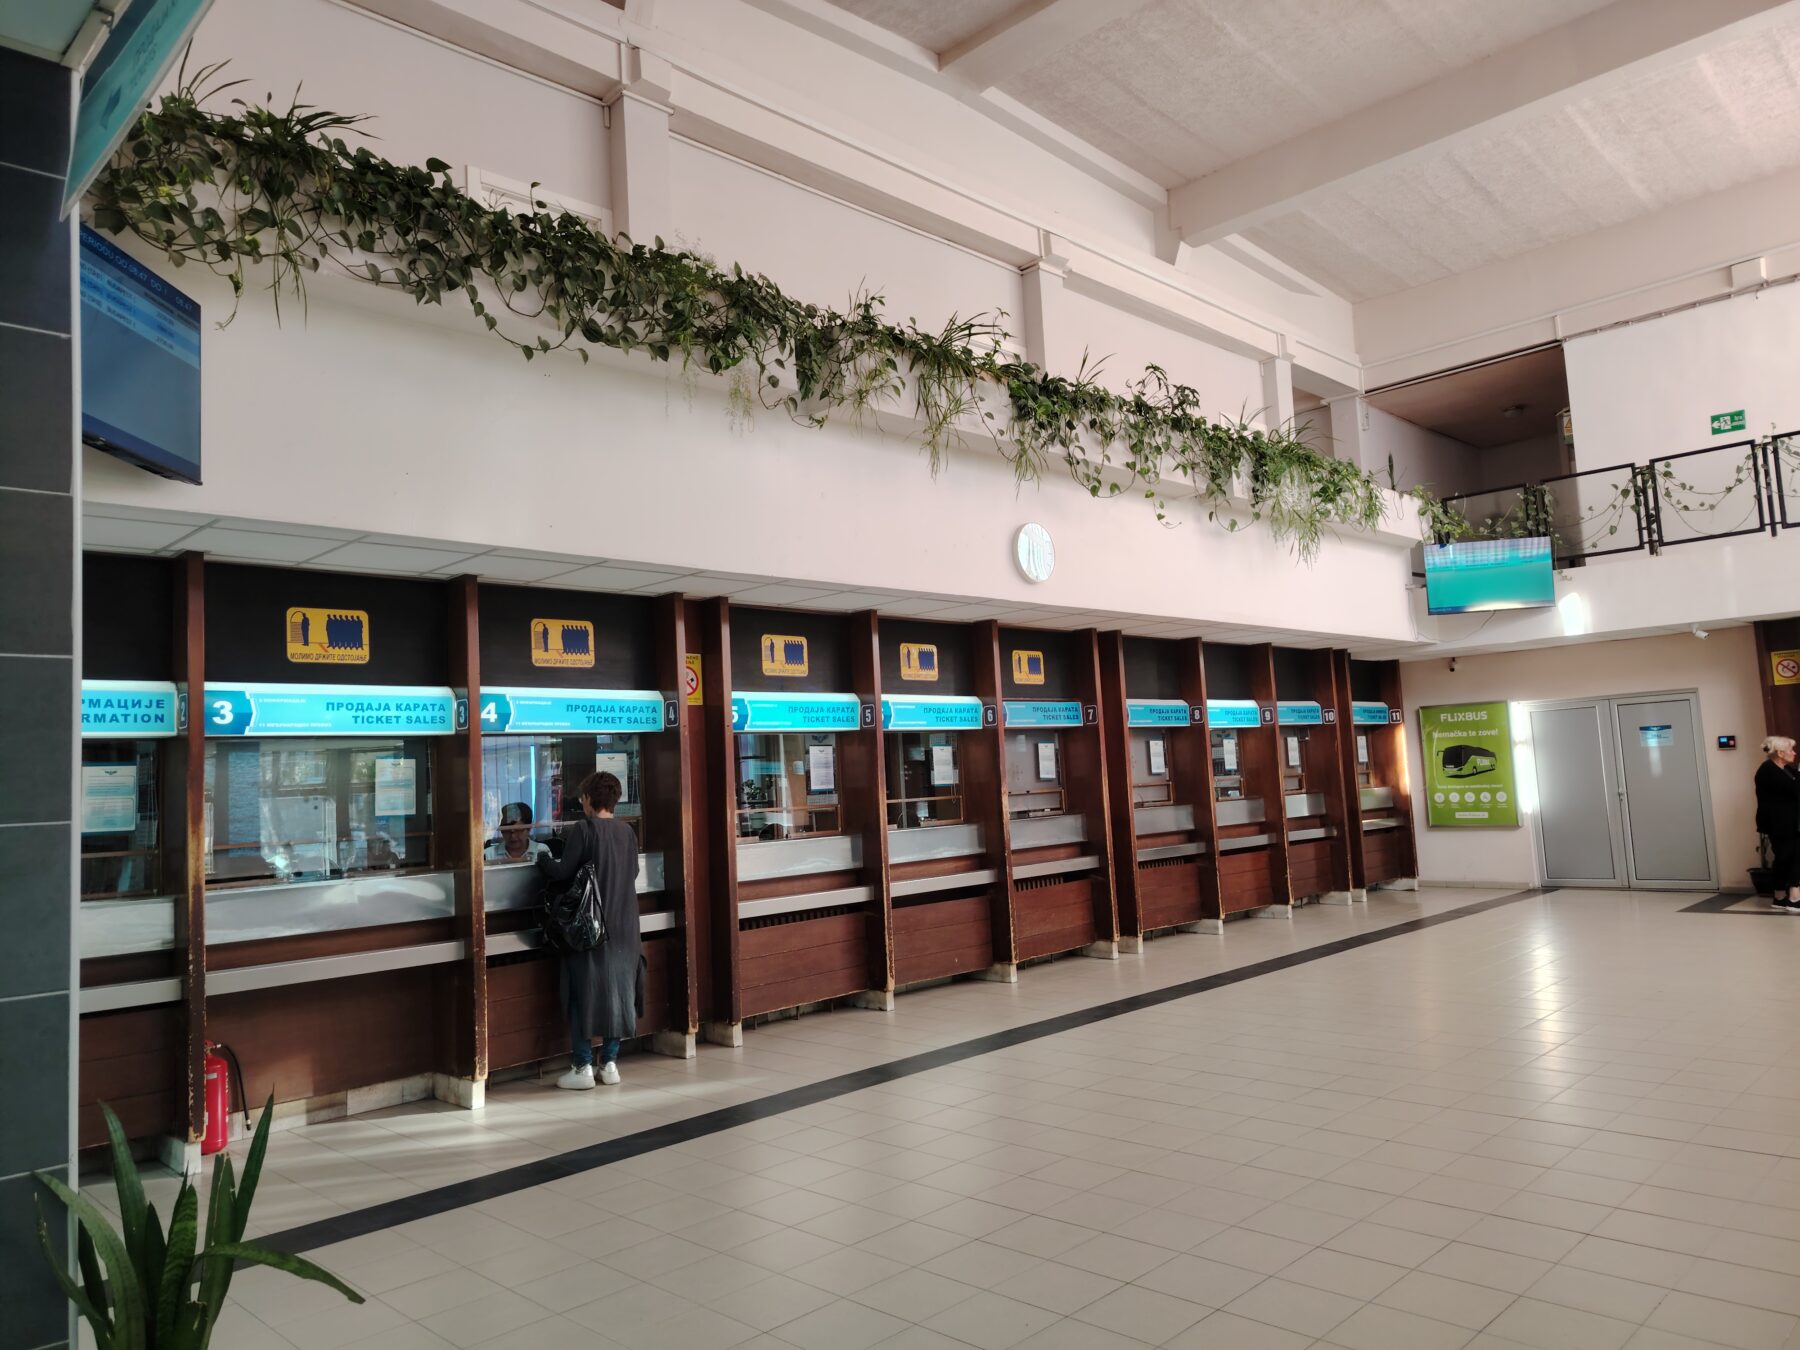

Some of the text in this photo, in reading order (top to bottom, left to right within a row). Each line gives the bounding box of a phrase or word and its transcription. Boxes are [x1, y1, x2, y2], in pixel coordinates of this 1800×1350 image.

[181, 702, 186, 722] 2
[212, 700, 234, 725] 3
[326, 702, 446, 713] ПРОДАЈА КАРАТА
[480, 702, 498, 723] 4
[566, 704, 657, 714] ПРОДАЈА КАРАТА
[788, 706, 824, 714] ПРОДАЈА
[459, 706, 465, 724] 3
[668, 706, 675, 721] 4
[802, 715, 855, 723] TICKET SALES
[865, 709, 871, 722] 5
[987, 709, 993, 722] 6
[1087, 709, 1094, 721] 7
[1194, 709, 1201, 720] 8
[1264, 711, 1271, 721] 9
[1324, 711, 1335, 722] 10
[1391, 711, 1400, 721] 11
[352, 715, 446, 724] TICKET SALES
[586, 715, 657, 724] TICKET SALES
[1432, 730, 1467, 739] Nemačka
[1468, 730, 1476, 738] te
